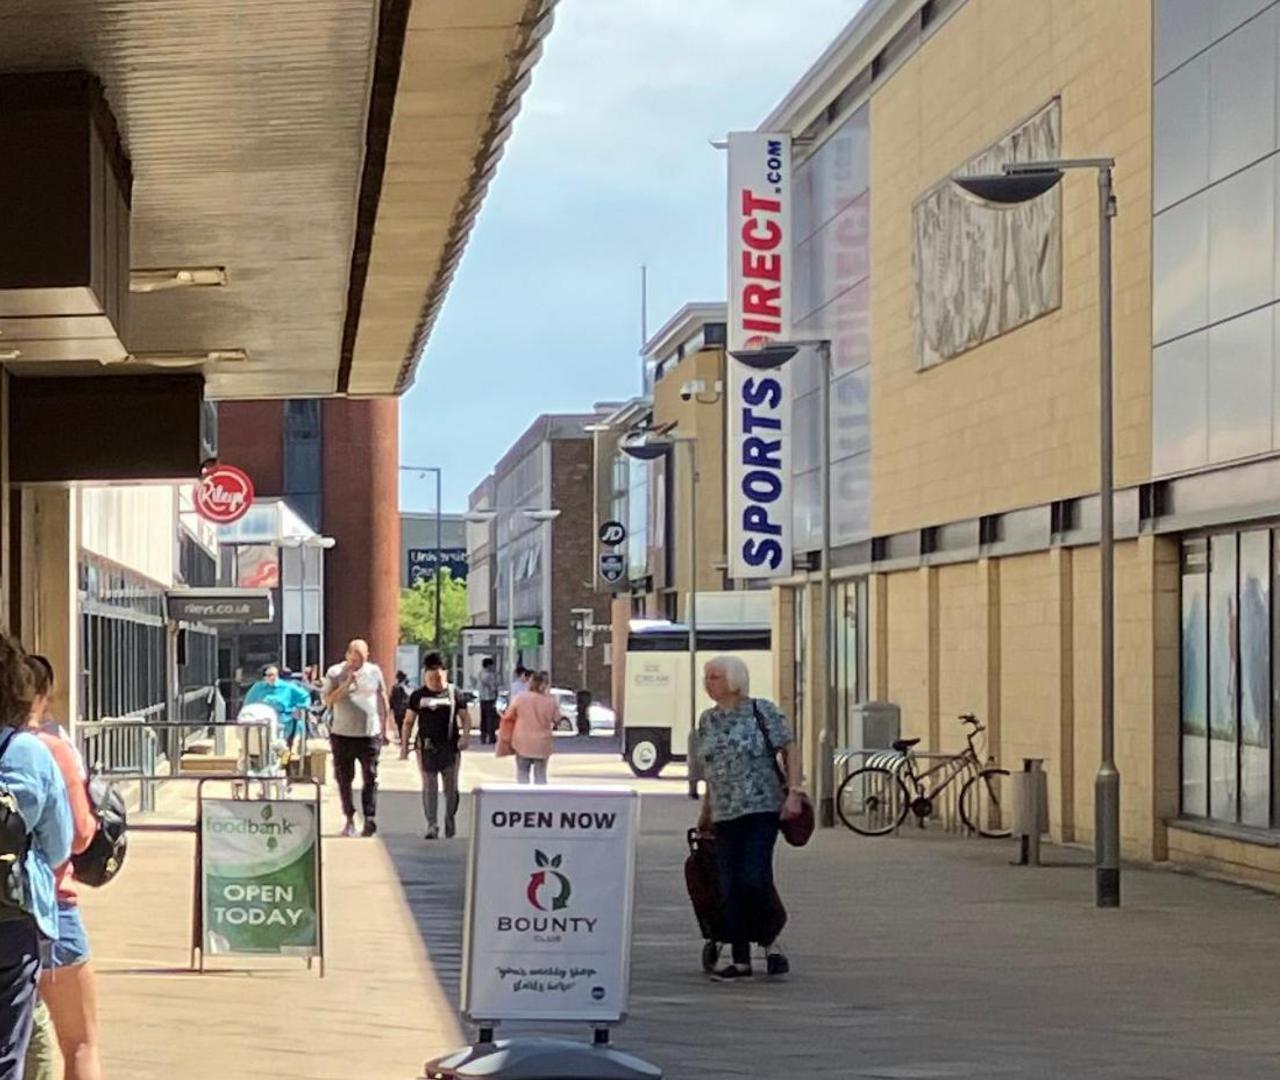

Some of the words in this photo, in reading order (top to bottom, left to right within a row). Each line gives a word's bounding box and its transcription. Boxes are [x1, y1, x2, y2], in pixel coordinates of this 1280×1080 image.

[741, 377, 783, 571] SPORTS
[602, 526, 622, 540] JD
[206, 818, 293, 835] foodbank
[491, 811, 553, 828] OPEN
[560, 812, 616, 829] NOW
[223, 884, 293, 902] OPEN
[214, 908, 303, 925] TODAY
[497, 917, 597, 932] BOUNTY
